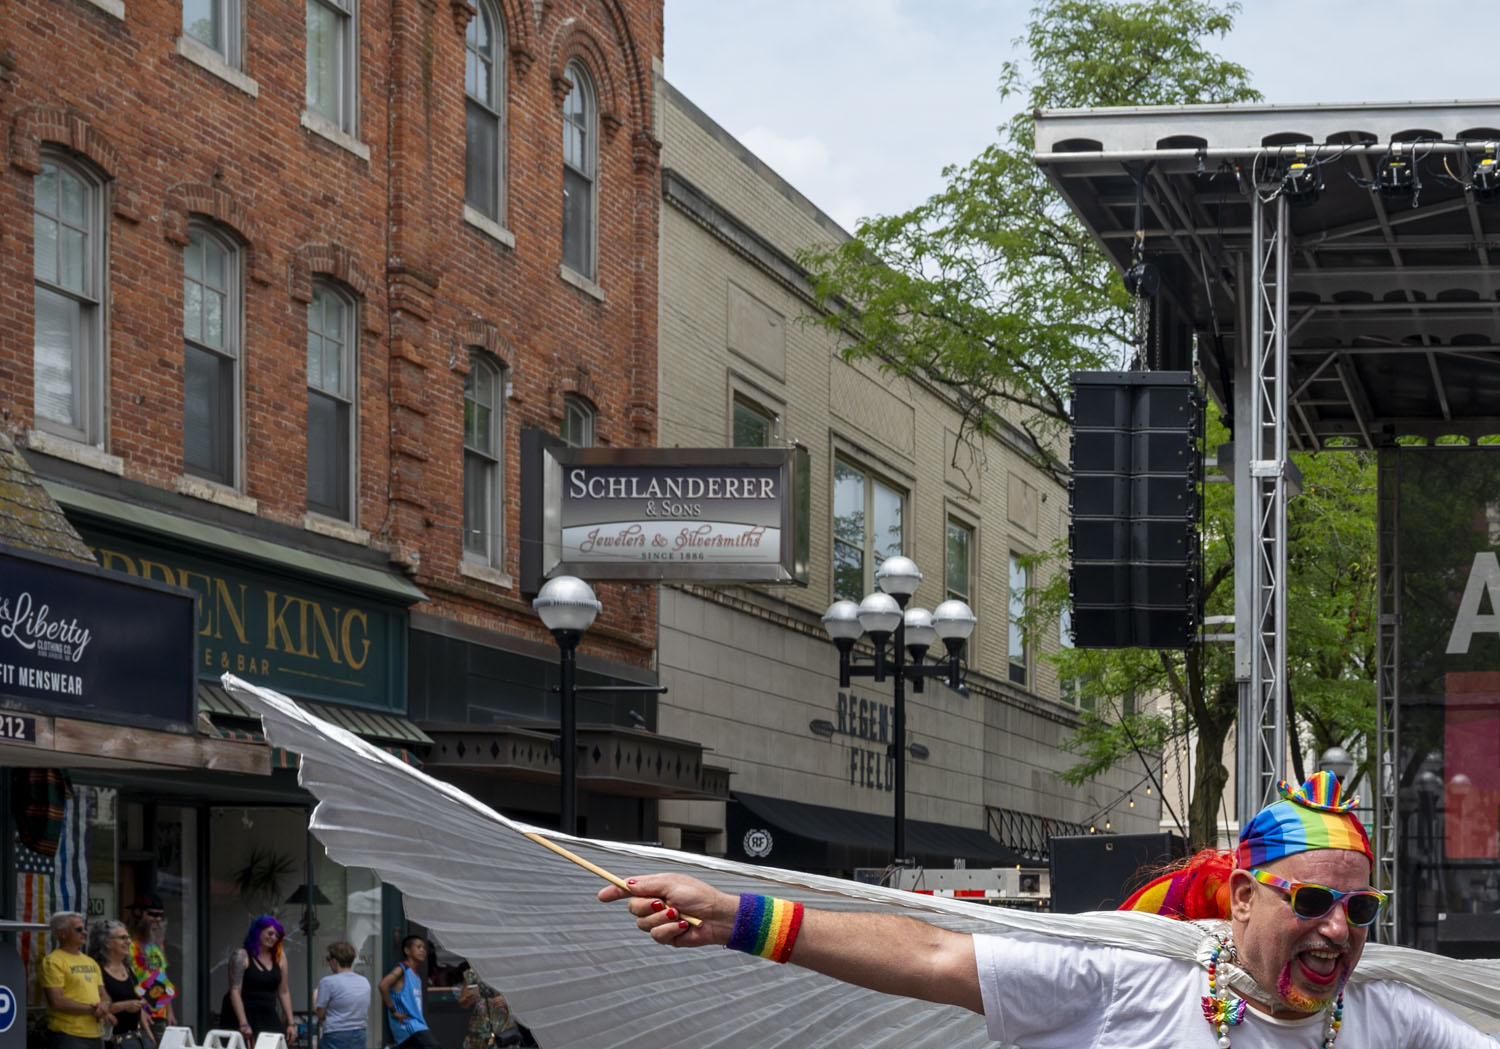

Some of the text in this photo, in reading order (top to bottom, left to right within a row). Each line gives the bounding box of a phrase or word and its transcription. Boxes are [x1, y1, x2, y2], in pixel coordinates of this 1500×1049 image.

[569, 468, 776, 500] SCHLANDERER
[645, 500, 702, 518] & SONS
[579, 524, 769, 554] Jewelers & Silversmiths
[641, 552, 705, 561] SINCE 1886
[1, 591, 92, 663] Liberty
[264, 590, 372, 671] KING
[37, 639, 73, 656] CLOTHING CO.
[220, 651, 231, 669] &
[237, 654, 270, 677] BAR
[19, 666, 83, 696] MENSWEAR
